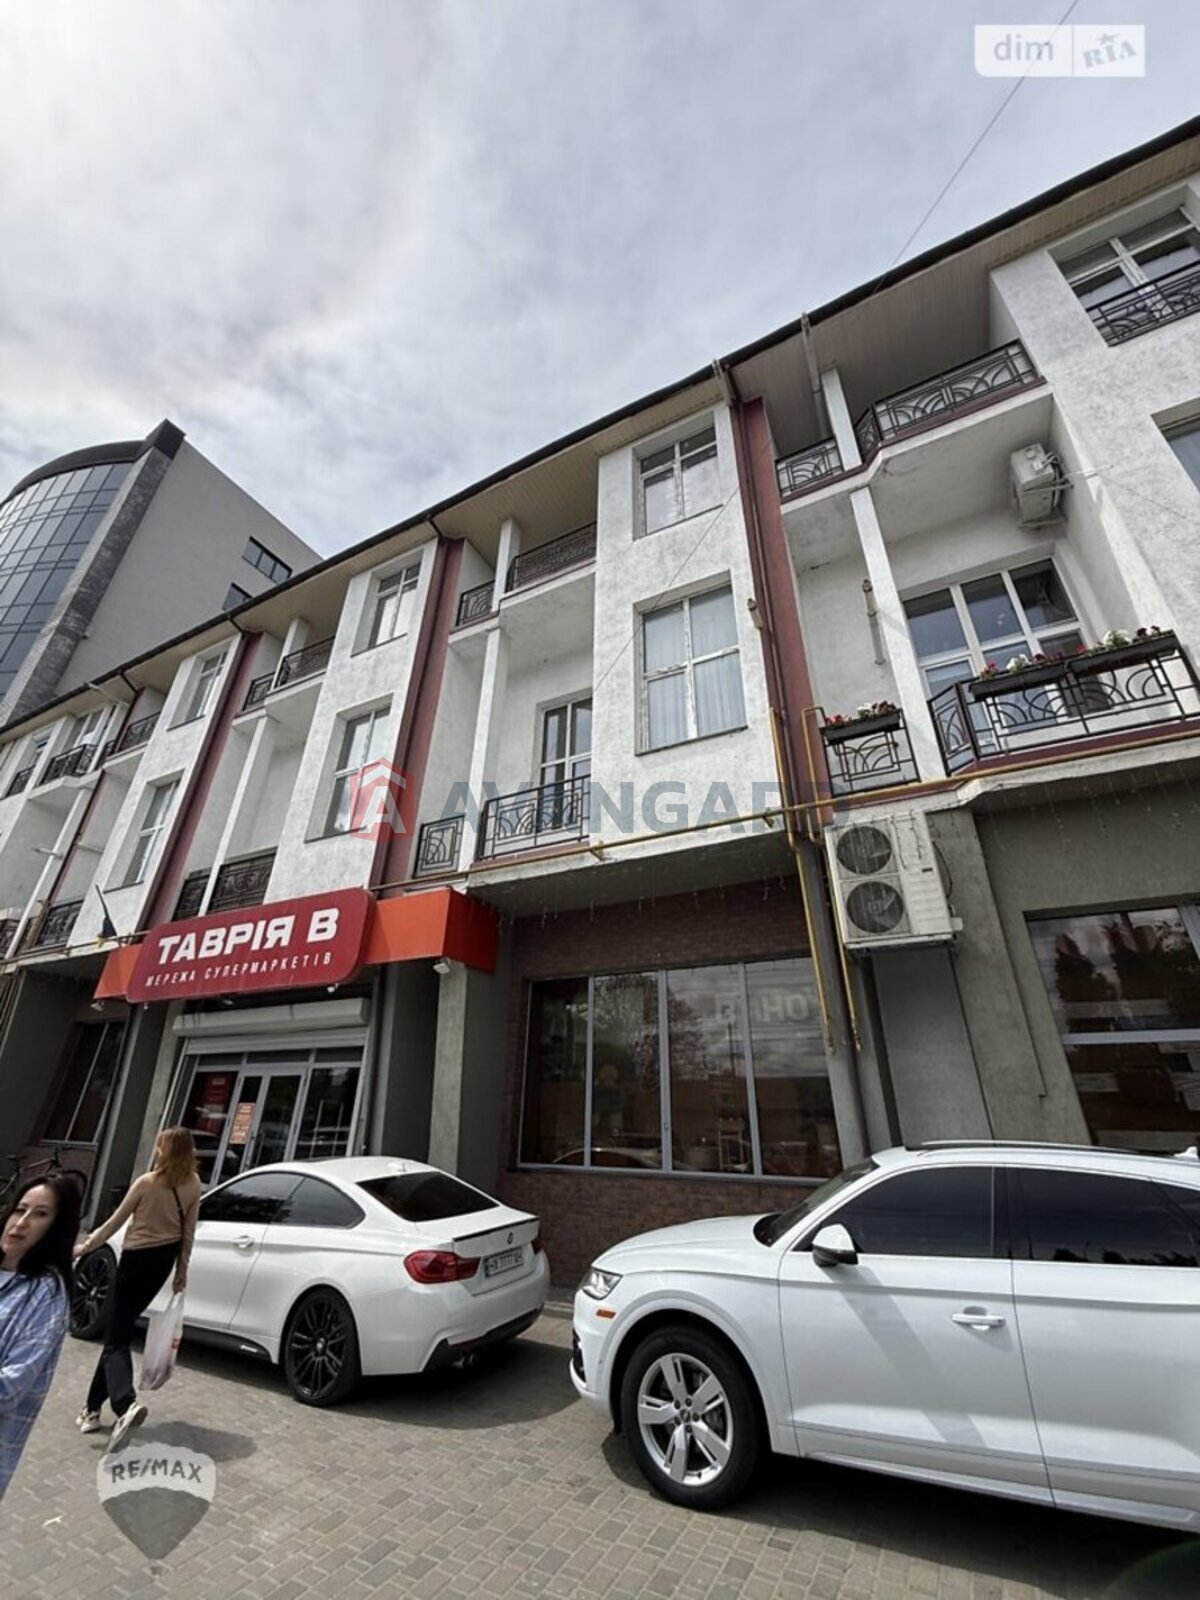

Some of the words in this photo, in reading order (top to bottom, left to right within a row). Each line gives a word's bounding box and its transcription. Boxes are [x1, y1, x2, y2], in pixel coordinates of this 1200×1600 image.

[158, 915, 295, 964] ТАВРІЯ
[306, 908, 340, 943] В
[145, 969, 197, 988] МЕРЕЖА
[204, 952, 332, 979] СУПЕРМАРКЕТІВ
